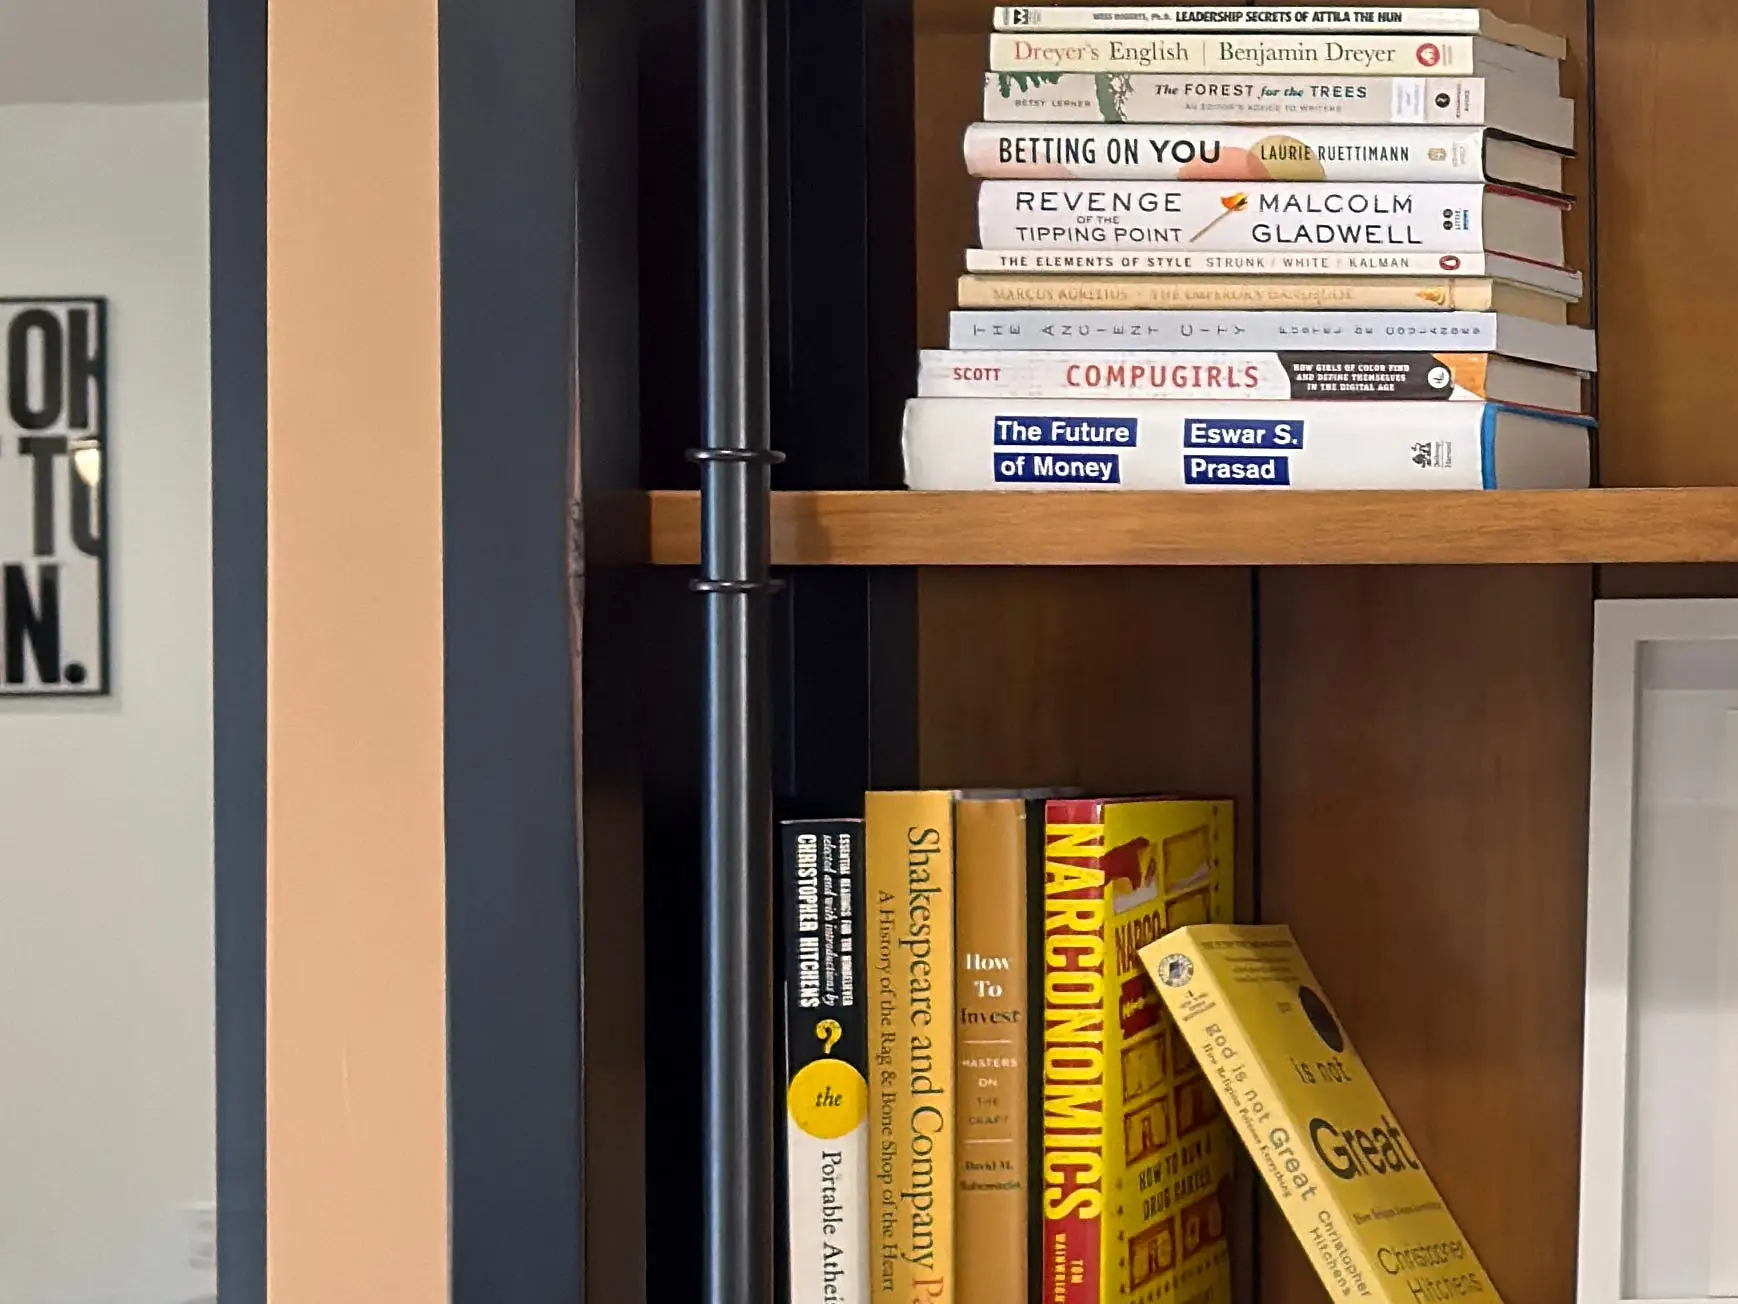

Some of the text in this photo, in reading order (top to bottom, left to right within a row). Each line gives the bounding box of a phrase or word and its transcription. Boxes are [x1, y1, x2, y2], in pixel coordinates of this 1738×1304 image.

[1175, 11, 1402, 22] LEADERSHIP SECRETS OF ATTILA THE HUN
[1014, 40, 1396, 66] Dreyer's English Benjamin Dreyer
[1000, 138, 1409, 164] BETTING ON YOU LAURIE RUETTIMANN
[1016, 192, 1182, 212] REVENGE
[1260, 194, 1412, 214] MALCOLM
[1016, 226, 1182, 242] TIPPING POINT
[1252, 224, 1422, 244] GLADWELL
[1000, 256, 1409, 268] THE ELEMENTS OF STYLE STRUNK WHITE KALMAN
[953, 364, 1258, 388] SCOTT COMPUGIRLS
[997, 420, 1130, 442] The Future
[1190, 423, 1298, 446] Eswar S.
[1000, 457, 1113, 482] of Money
[1190, 458, 1276, 480] Prasad
[898, 826, 942, 1026] Shakespeare
[966, 953, 1010, 970] How
[974, 980, 1002, 998] To
[960, 1008, 1020, 1023] Invest
[1044, 823, 1106, 1220] NARCONOMICS
[910, 1036, 944, 1096] and
[962, 1058, 1018, 1068] MASTERS
[1290, 1056, 1352, 1084] is not
[978, 1078, 998, 1088] ON
[815, 1086, 842, 1107] the
[1205, 1023, 1318, 1200] god is not Great
[1308, 1114, 1421, 1180] Great
[822, 1150, 843, 1235] Portable
[900, 1108, 944, 1270] Company
